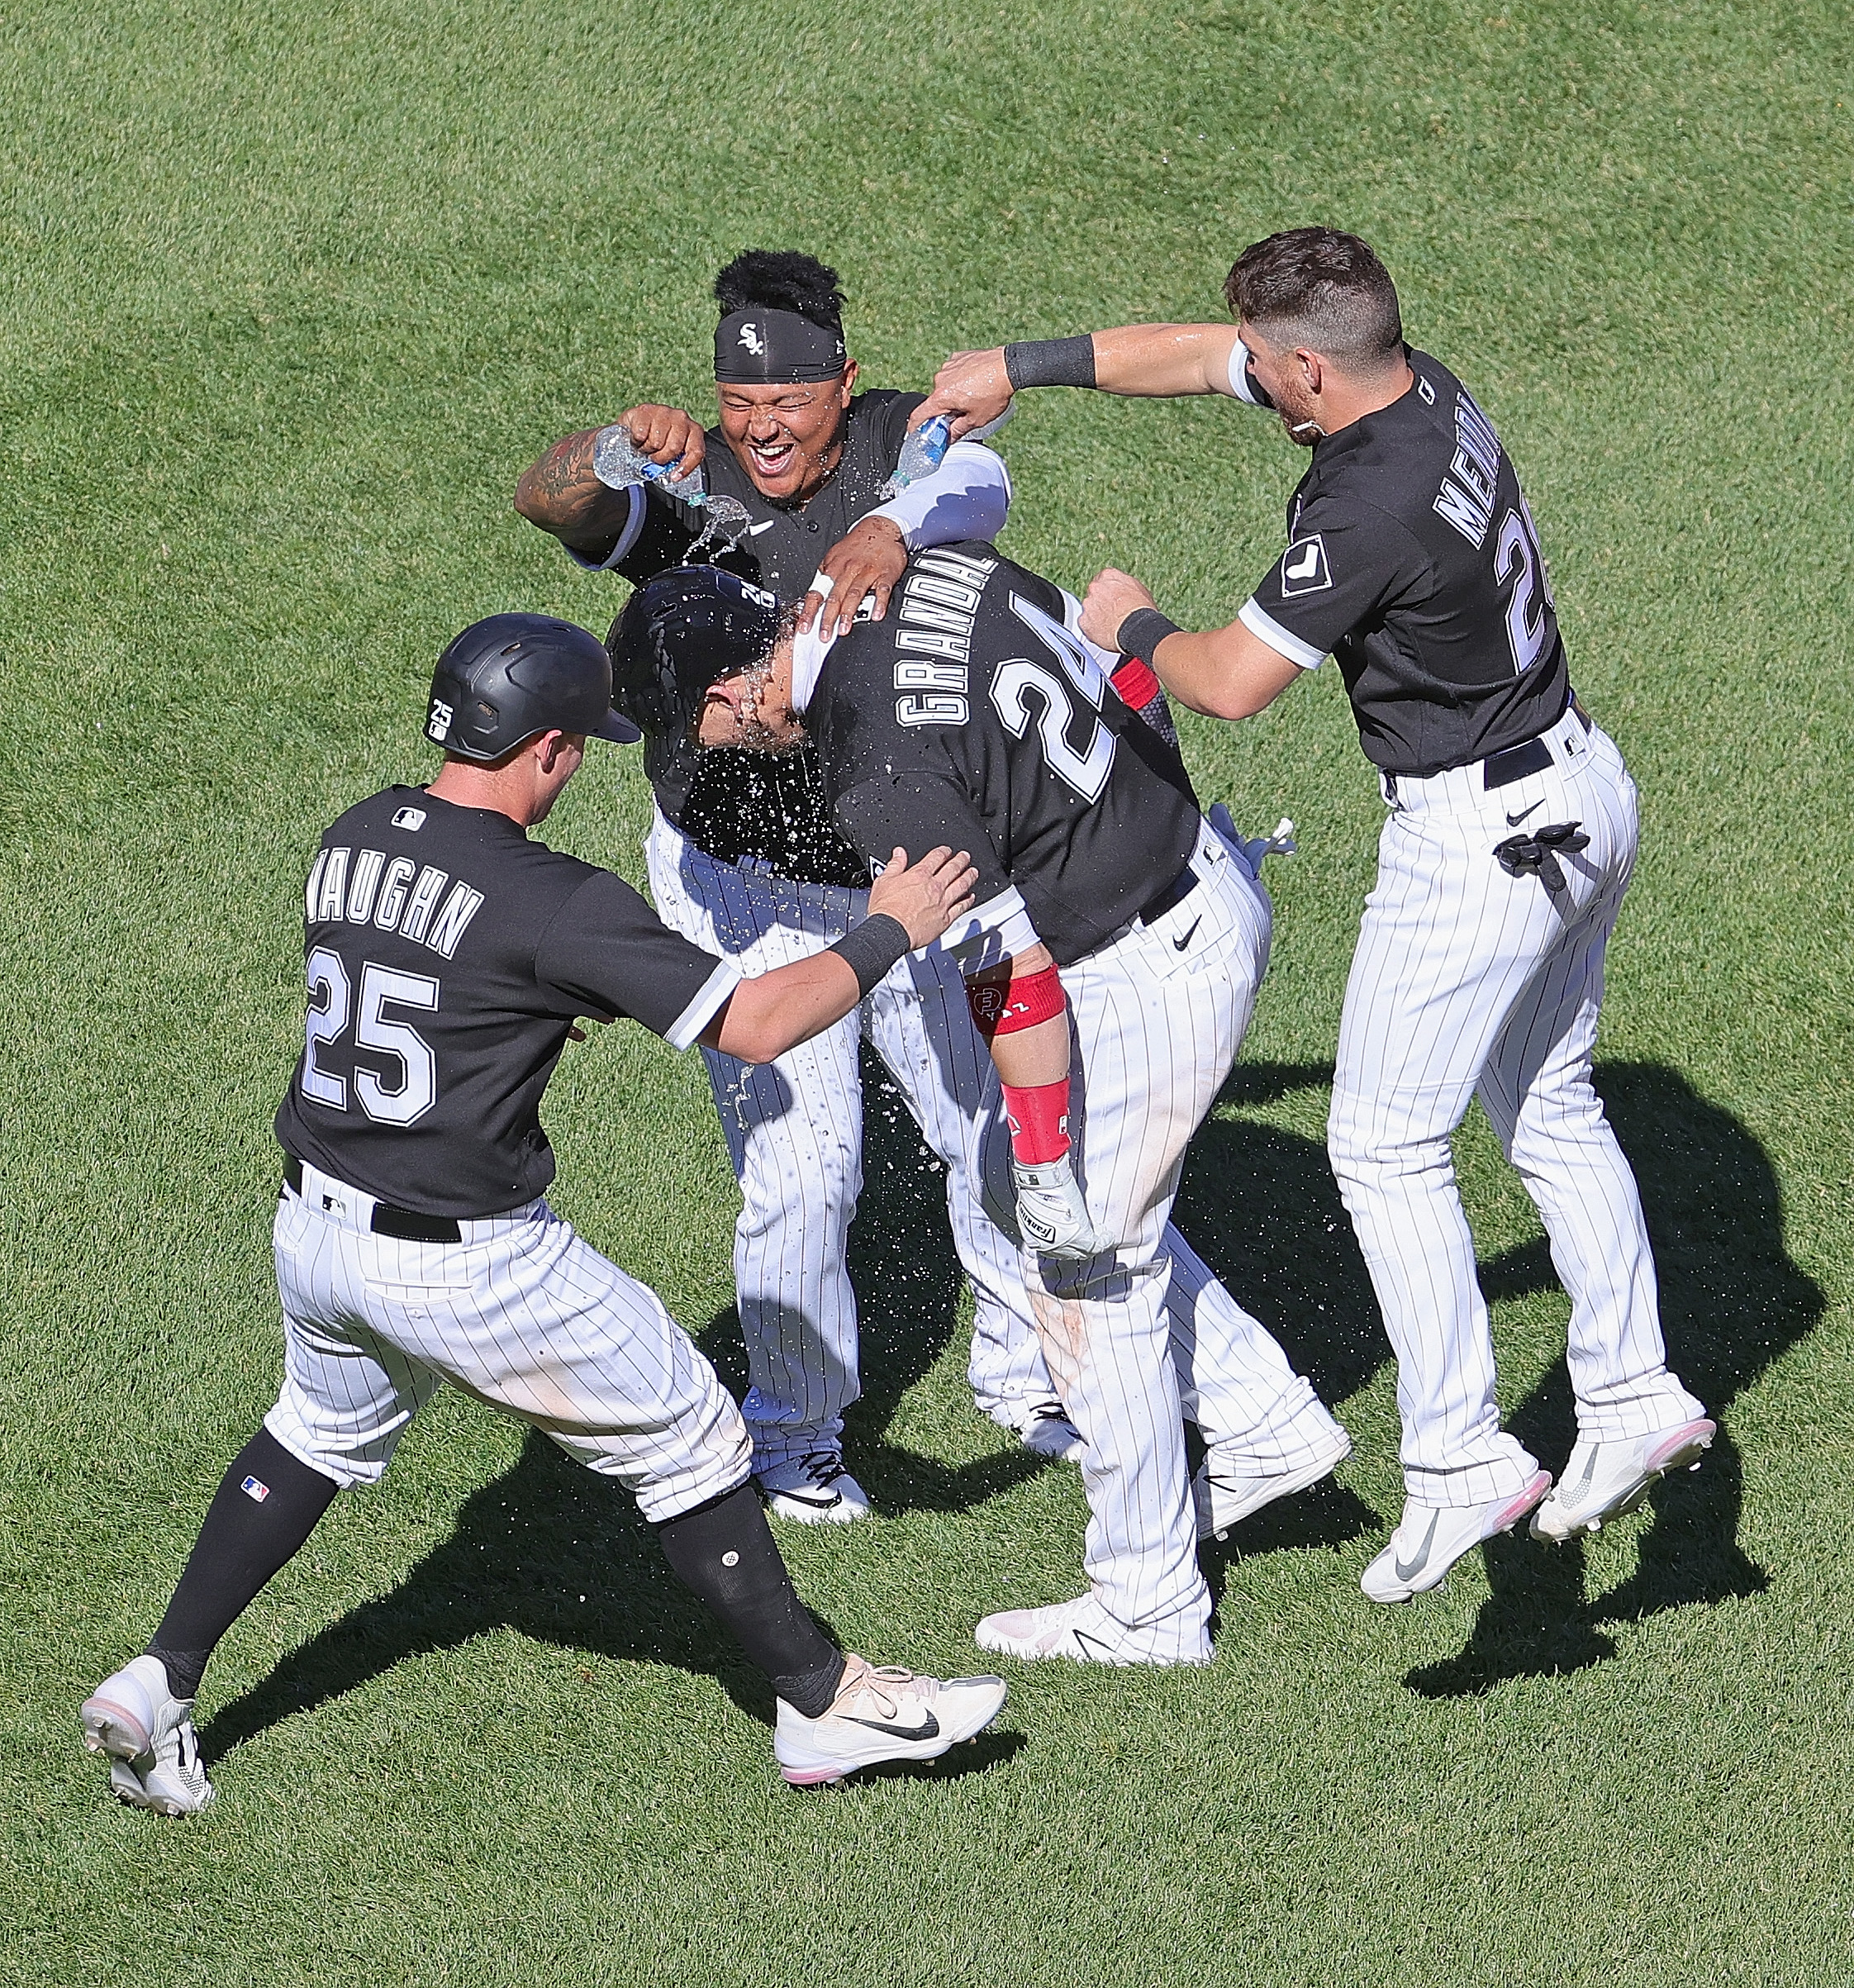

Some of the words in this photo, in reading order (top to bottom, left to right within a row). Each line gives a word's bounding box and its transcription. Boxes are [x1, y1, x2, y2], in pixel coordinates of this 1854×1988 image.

[737, 323, 763, 355] Sox
[1433, 392, 1501, 551] MENDI
[893, 548, 999, 727] GRANDAL
[1494, 492, 1556, 677] 2
[430, 698, 454, 728] 25
[988, 589, 1123, 805] 24
[306, 847, 486, 960] VAUGHN
[301, 945, 440, 1128] 25
